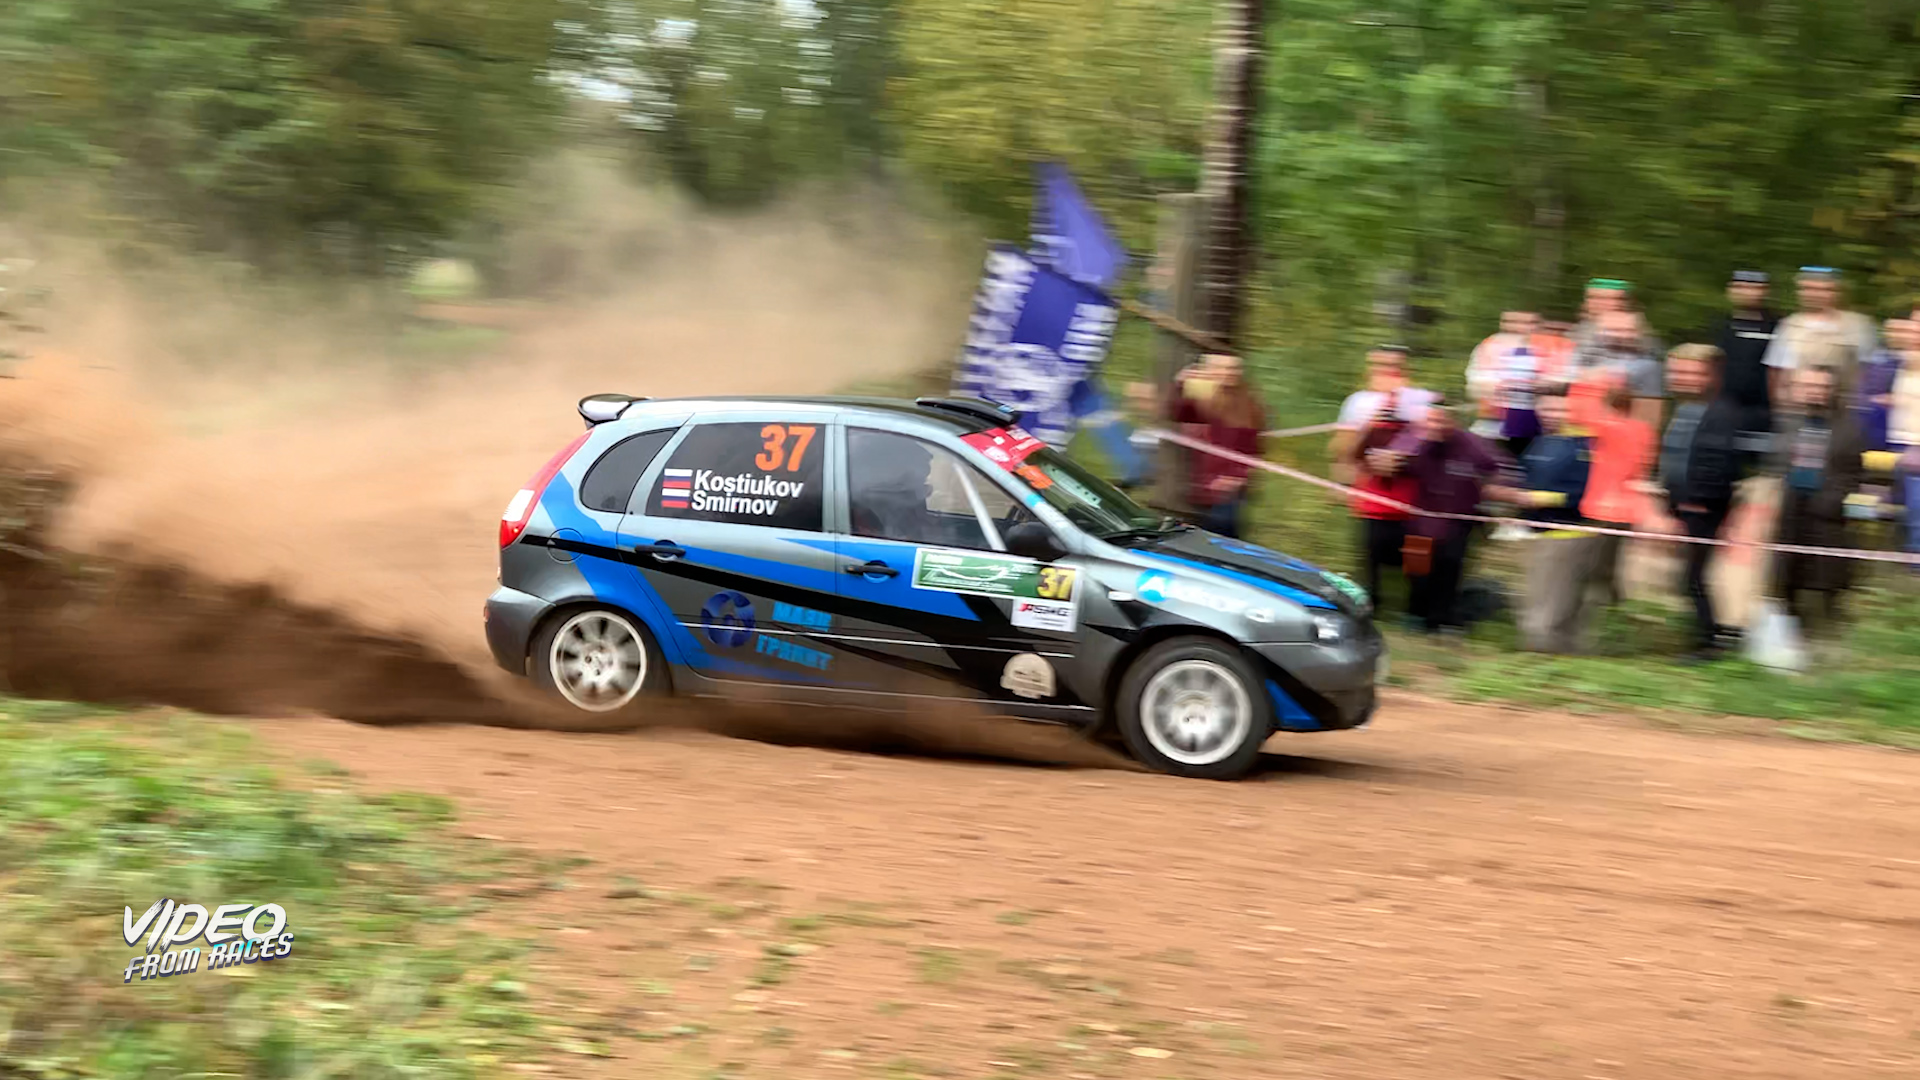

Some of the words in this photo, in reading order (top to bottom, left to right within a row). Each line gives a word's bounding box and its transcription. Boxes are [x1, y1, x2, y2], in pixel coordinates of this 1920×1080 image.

[755, 424, 817, 472] 37
[694, 469, 804, 498] Kostiukov
[691, 490, 779, 516] Smirnov
[1037, 567, 1075, 600] 37
